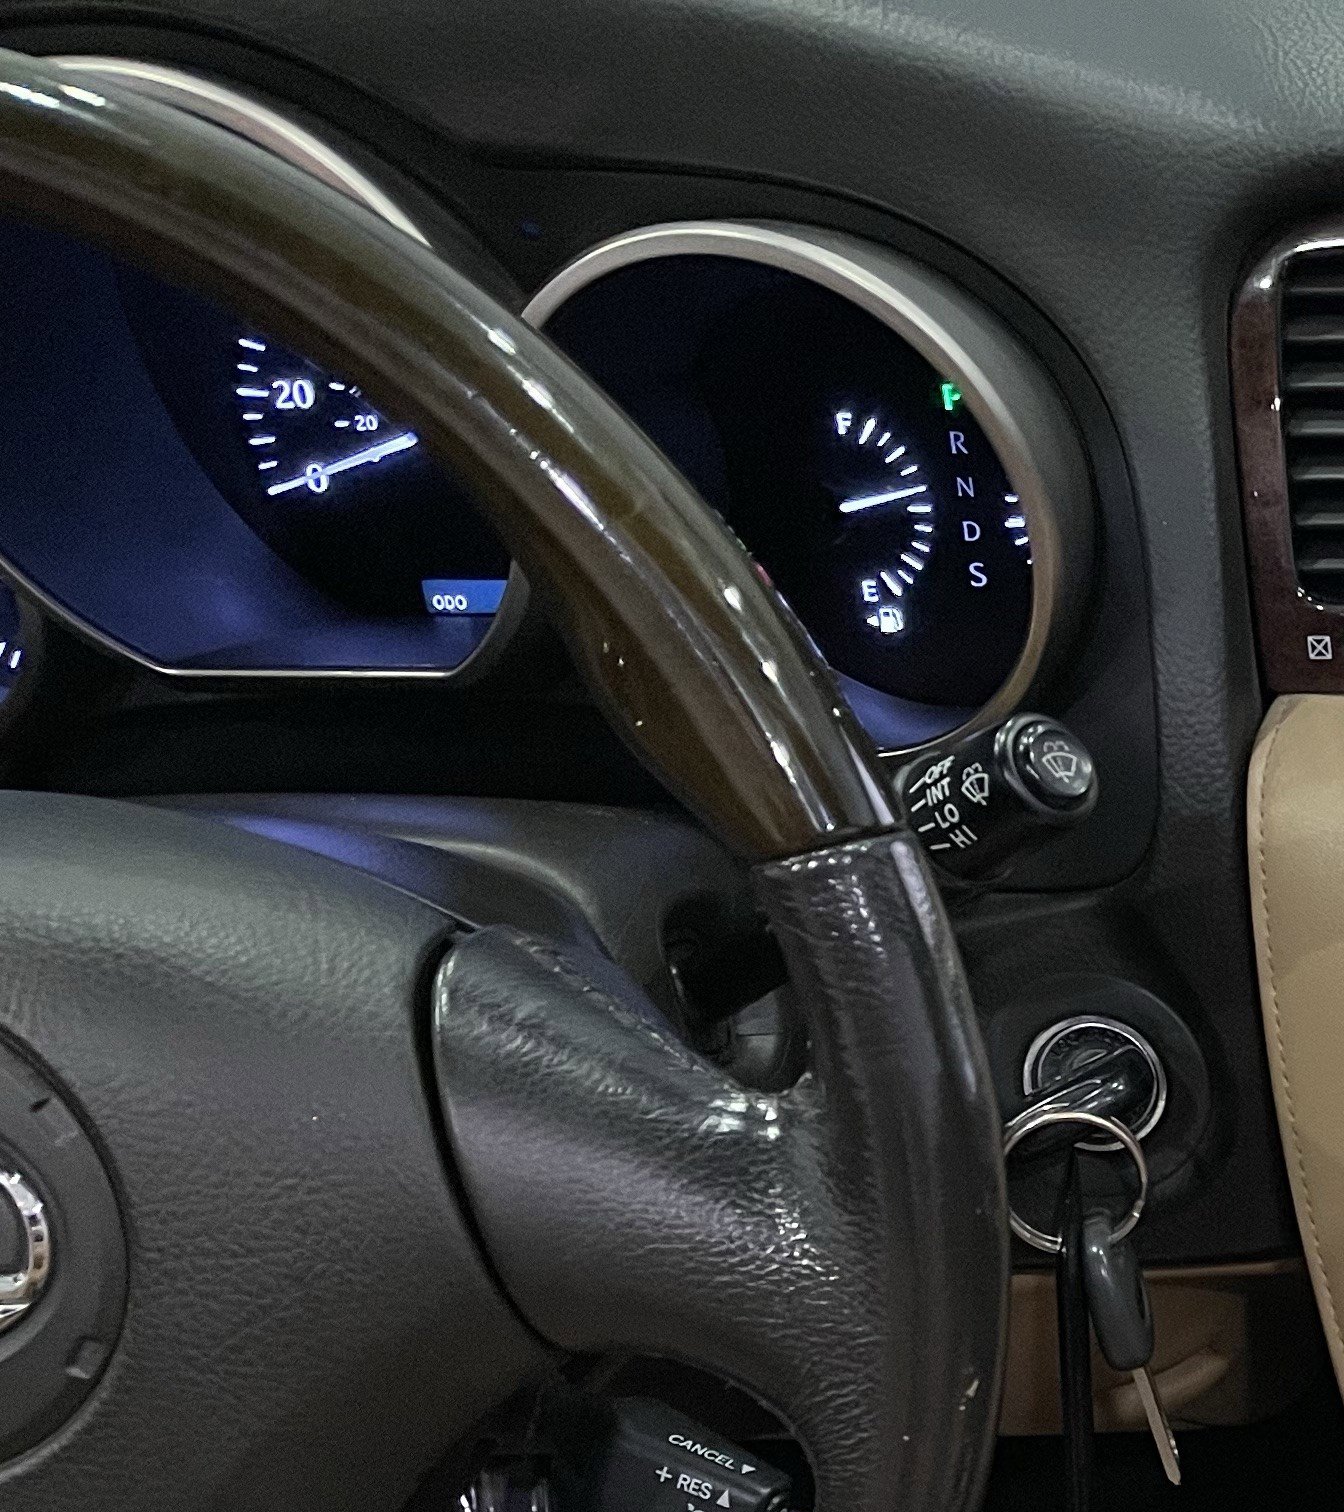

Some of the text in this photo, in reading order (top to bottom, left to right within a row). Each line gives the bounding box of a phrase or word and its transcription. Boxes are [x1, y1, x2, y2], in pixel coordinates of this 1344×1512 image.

[272, 380, 314, 409] 20
[355, 415, 378, 431] 20
[836, 412, 852, 434] F
[950, 431, 968, 454] R
[957, 477, 974, 497] N
[963, 521, 980, 541] D
[969, 562, 987, 587] S
[433, 595, 467, 610] ODO
[862, 580, 878, 602] E
[925, 755, 955, 784] OFF
[926, 777, 951, 806] INT
[935, 803, 960, 829] LO
[949, 825, 978, 848] HI
[669, 1434, 735, 1470] CANCEL
[676, 1473, 713, 1500] RES
